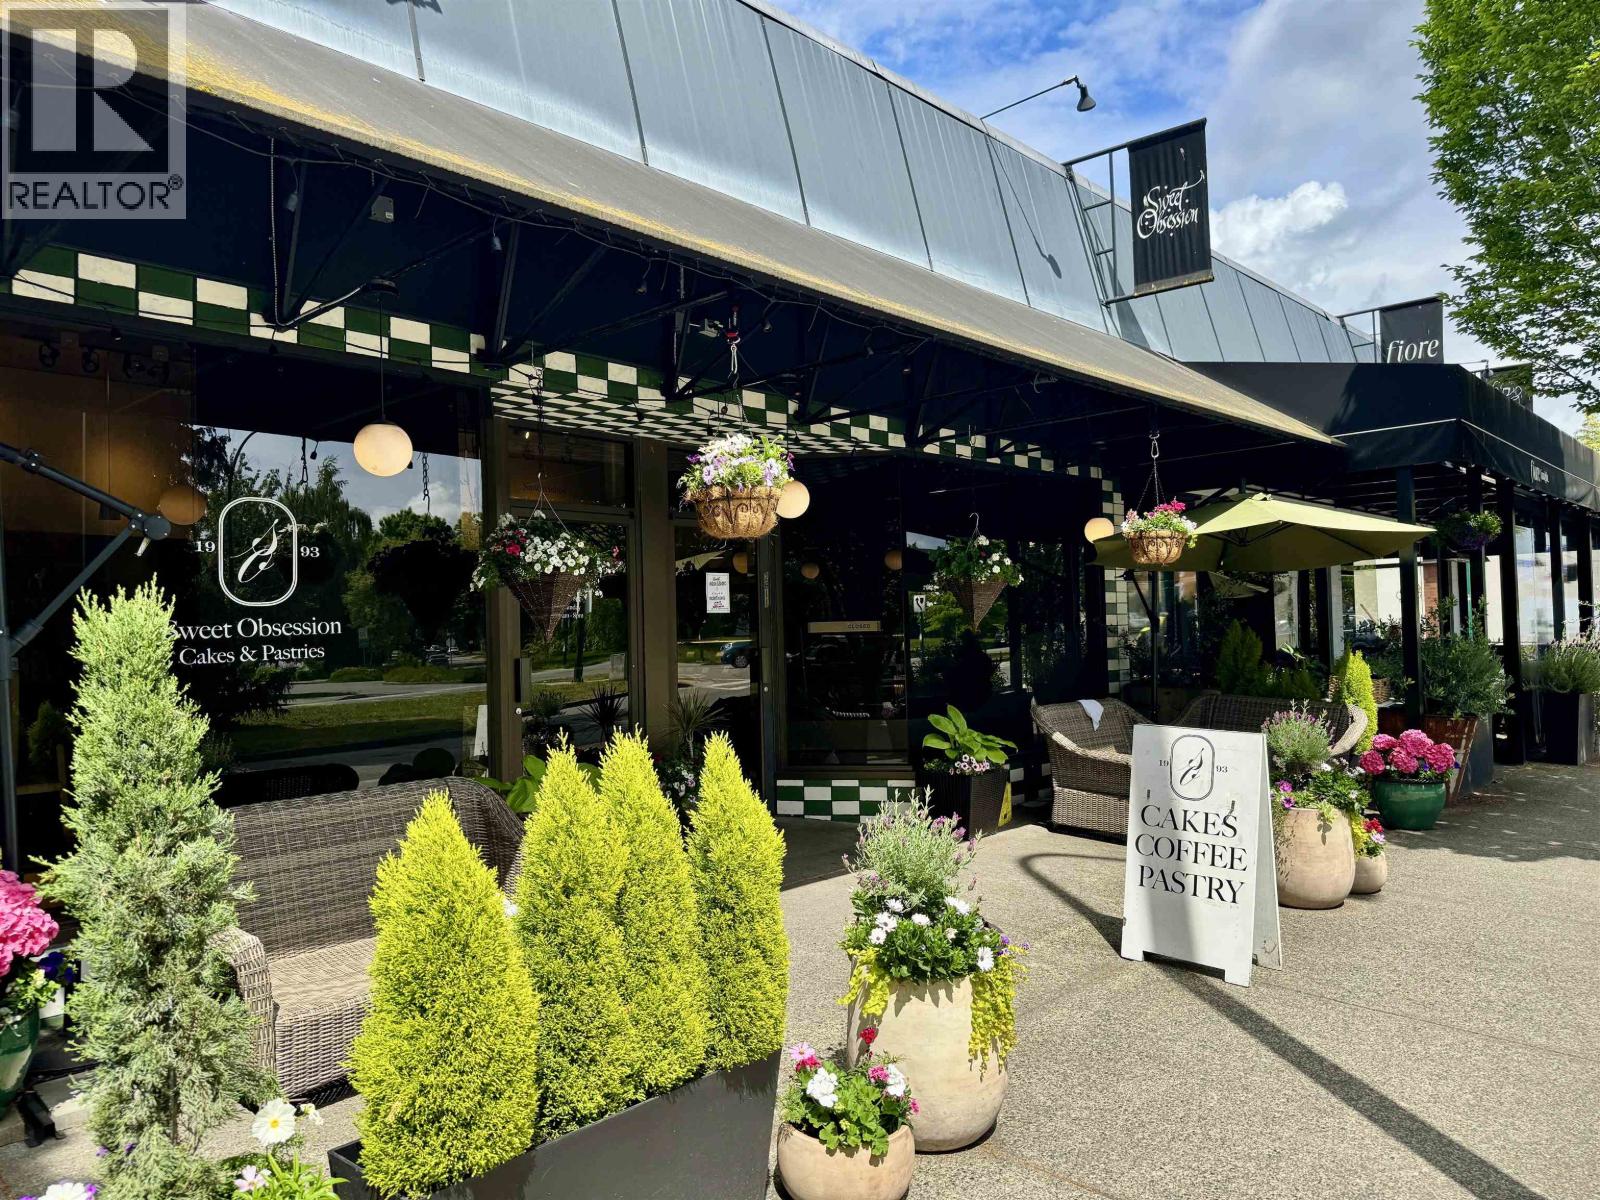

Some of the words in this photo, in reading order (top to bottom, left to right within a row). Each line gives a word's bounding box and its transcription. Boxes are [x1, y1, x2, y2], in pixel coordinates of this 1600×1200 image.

[1143, 170, 1204, 213] Sweet
[1136, 208, 1199, 239] Obsession
[1386, 338, 1440, 364] fiore
[195, 541, 216, 553] 19
[300, 546, 320, 558] 93
[237, 616, 342, 639] Obsession
[179, 647, 235, 666] Cakes
[239, 645, 258, 663] &
[262, 643, 325, 662] Pastries
[1159, 759, 1169, 767] 19
[1216, 765, 1228, 774] 93
[1140, 804, 1238, 838] CAKES
[1135, 833, 1248, 872] COFFEE
[1137, 865, 1247, 905] PASTRY
